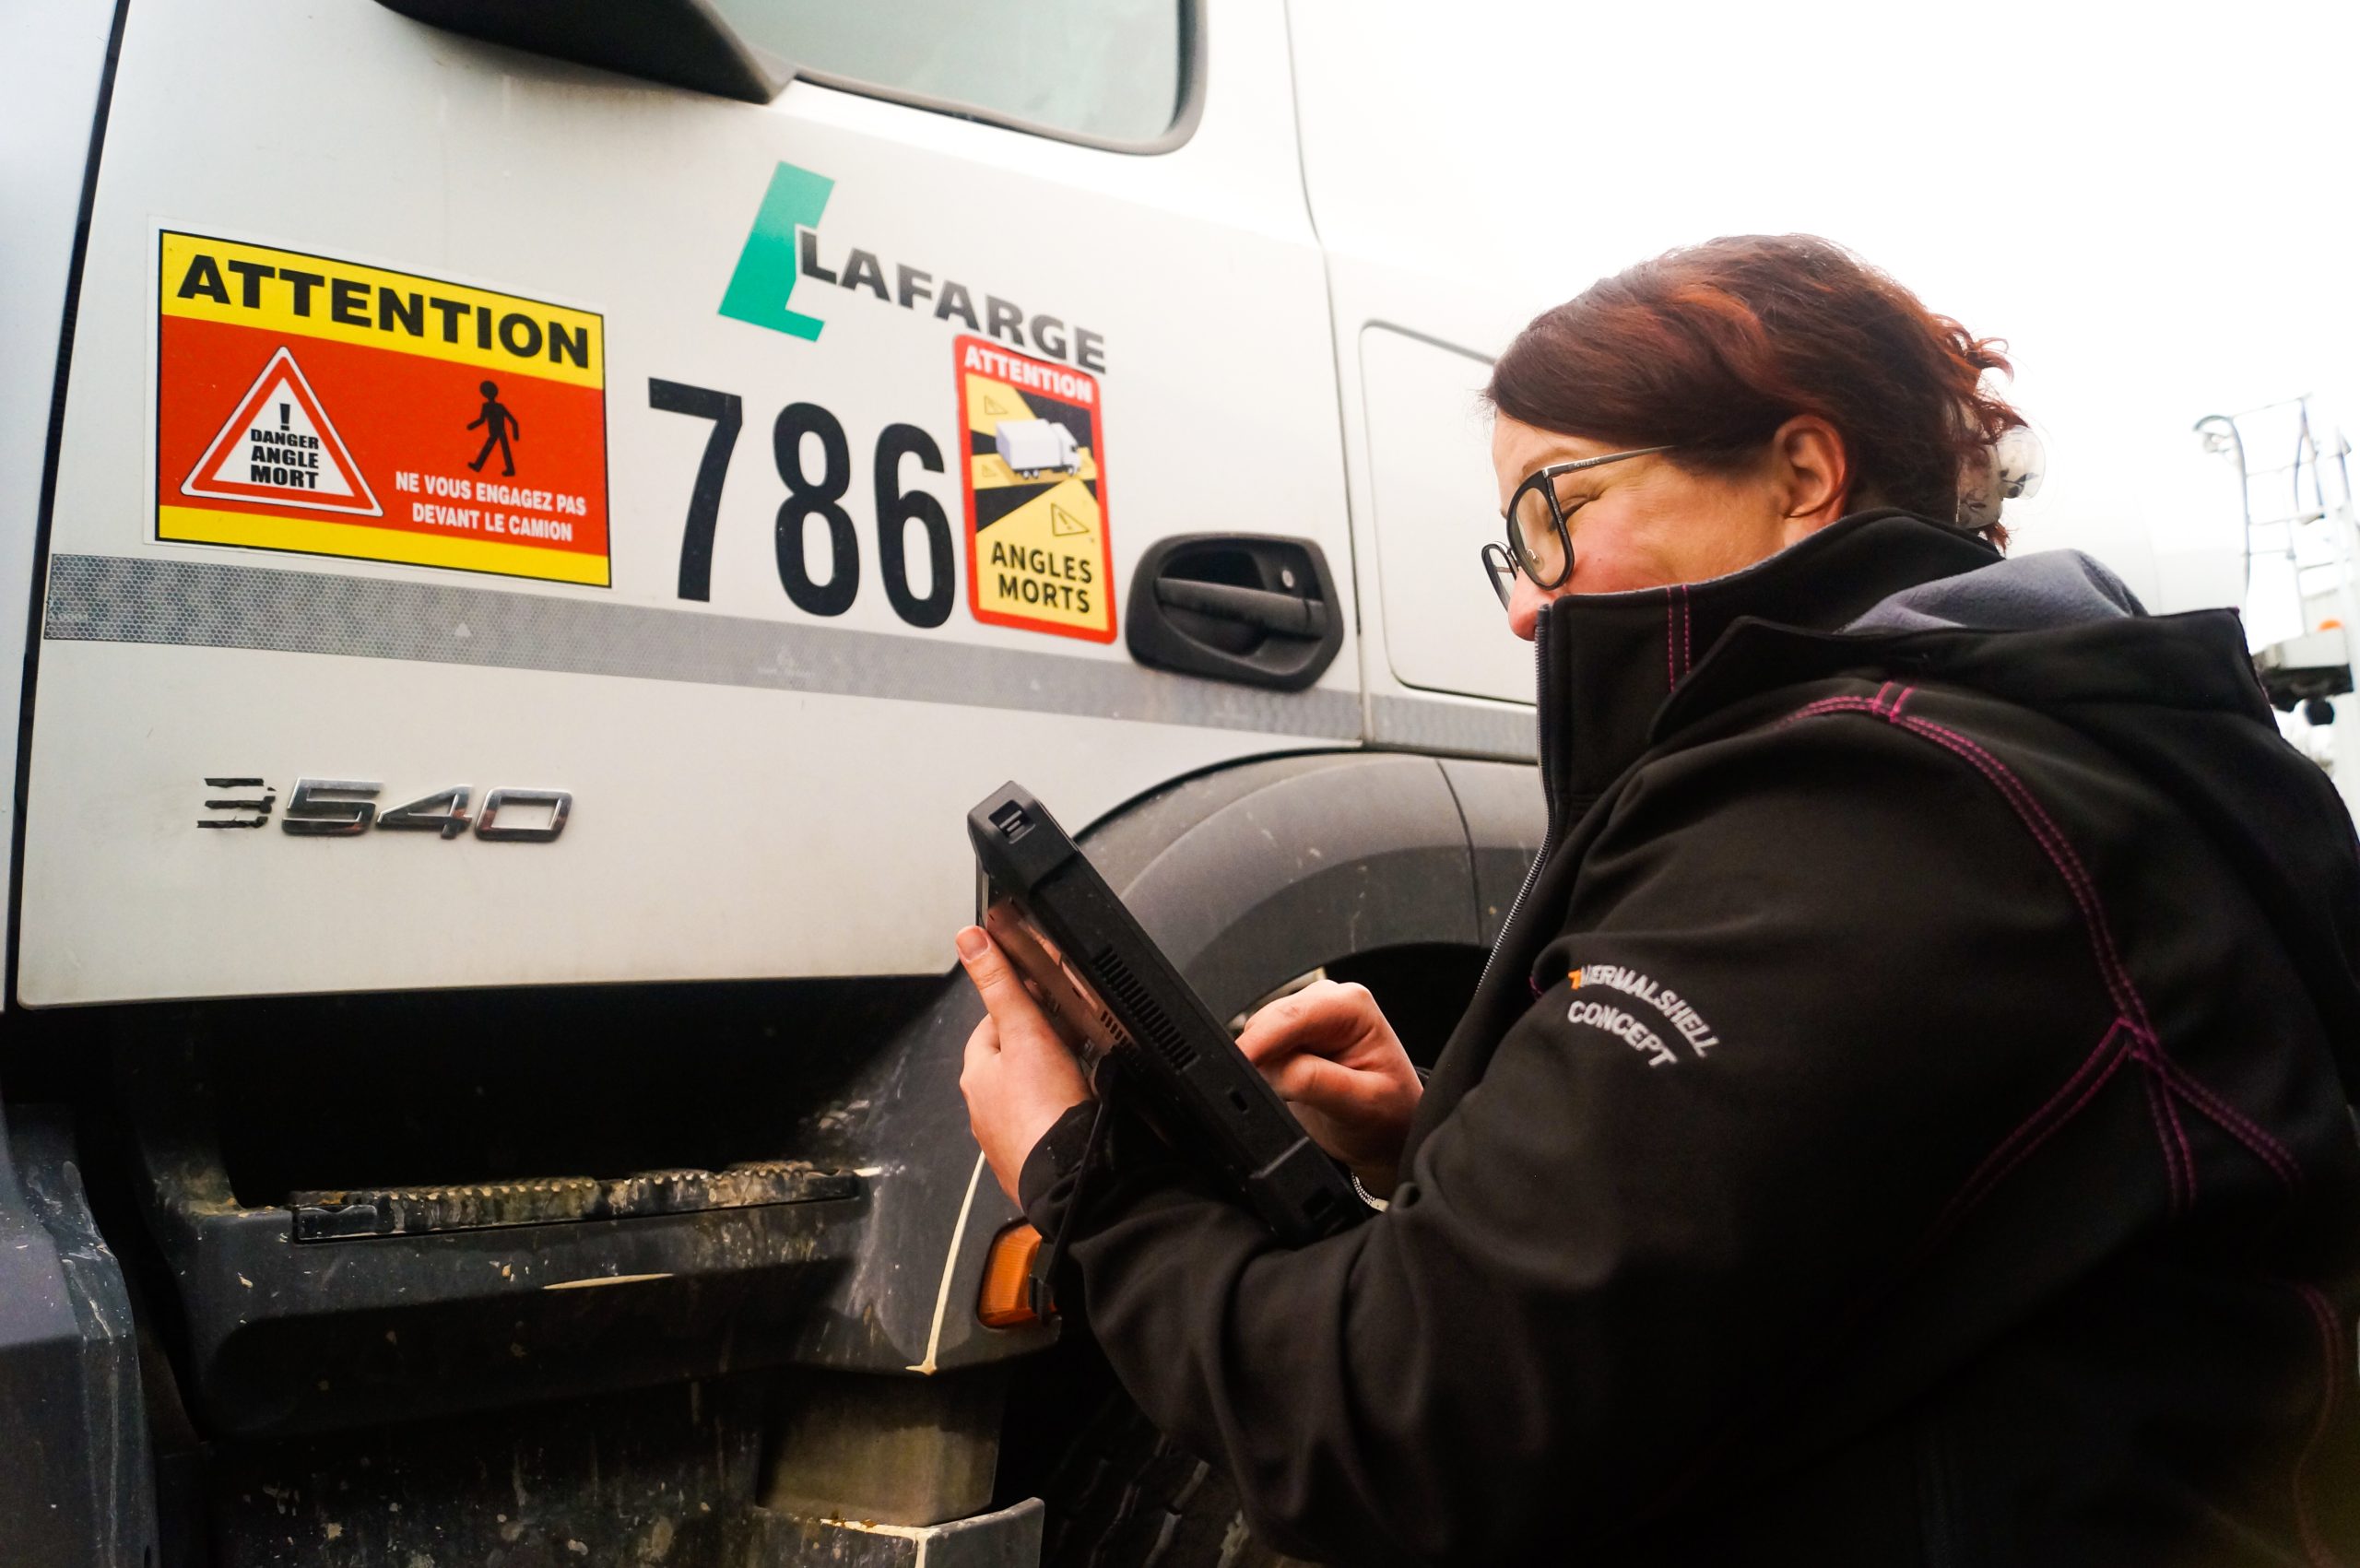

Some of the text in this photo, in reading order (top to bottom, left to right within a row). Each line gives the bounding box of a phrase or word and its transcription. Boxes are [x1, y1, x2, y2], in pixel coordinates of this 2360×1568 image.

[177, 253, 589, 369] ATTENTION
[800, 230, 1106, 374] LAFARGE
[963, 344, 1093, 404] ATTENTION
[250, 428, 319, 450] DANGER
[251, 444, 319, 470] ANGLE
[251, 466, 318, 489] MORT
[395, 471, 586, 516] NE VOUS ENGAGEZ PAS
[412, 502, 573, 542] DEVANT LE CAMION
[648, 376, 955, 629] 786
[990, 540, 1093, 584] ANGLES
[998, 572, 1092, 614] MORTS
[1567, 1000, 1679, 1068] CONCEPT
